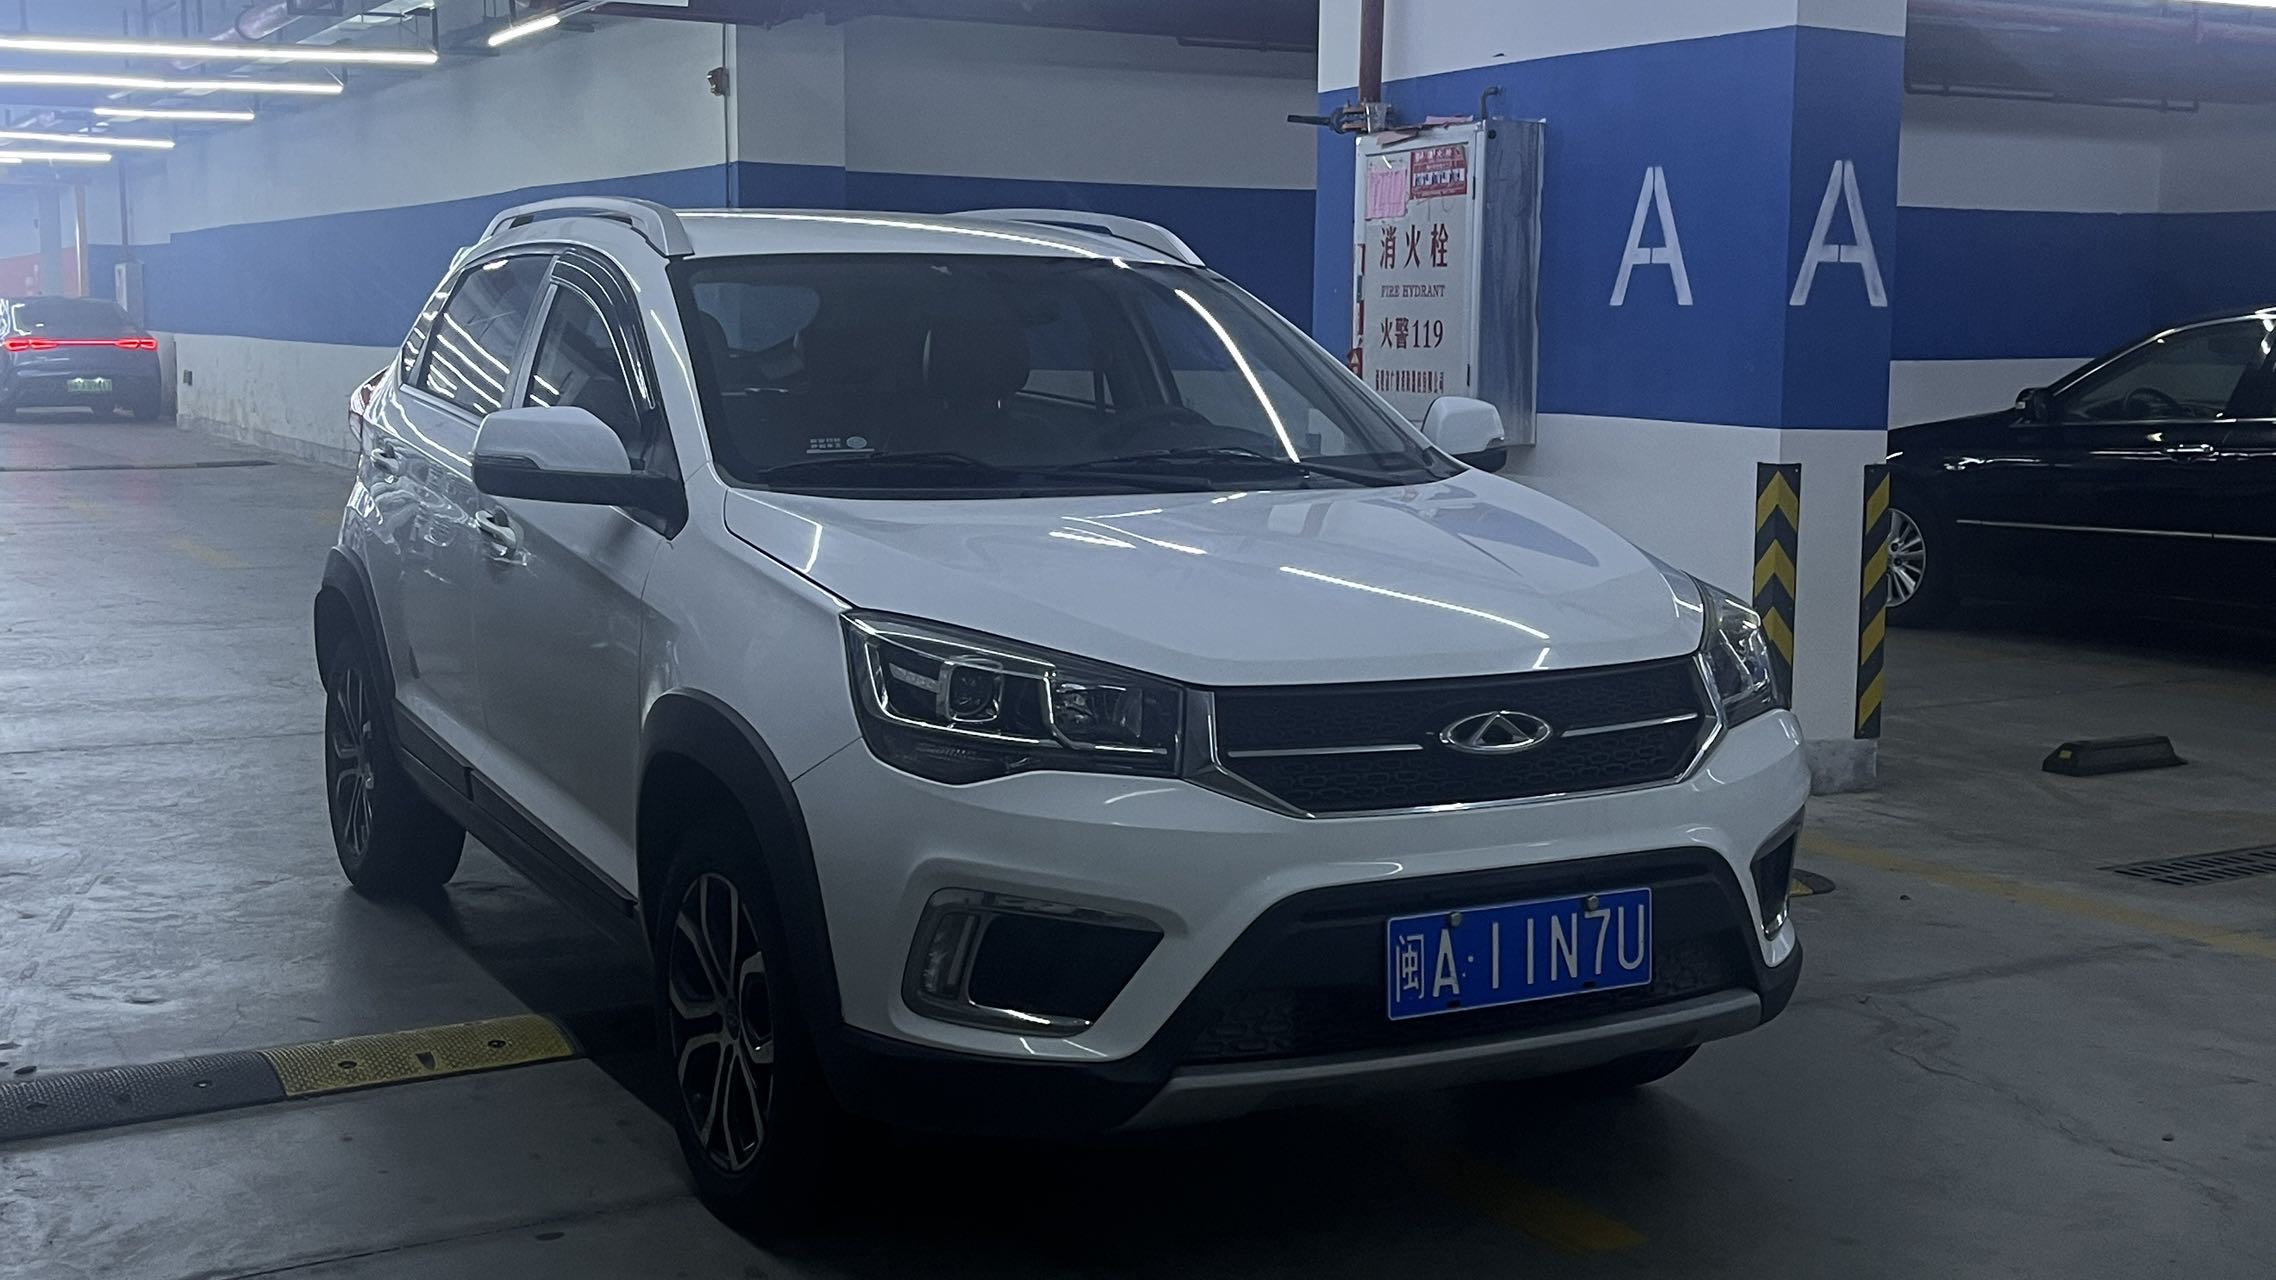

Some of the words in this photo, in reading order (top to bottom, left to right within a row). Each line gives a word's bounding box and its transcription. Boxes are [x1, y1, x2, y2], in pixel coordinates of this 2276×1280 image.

[1380, 223, 1449, 270] 消火栓
[1609, 166, 1693, 306] A
[1789, 160, 1888, 307] A
[1381, 285, 1400, 298] FIRE
[1402, 285, 1445, 298] HYDRANT
[1381, 317, 1443, 349] 火警119
